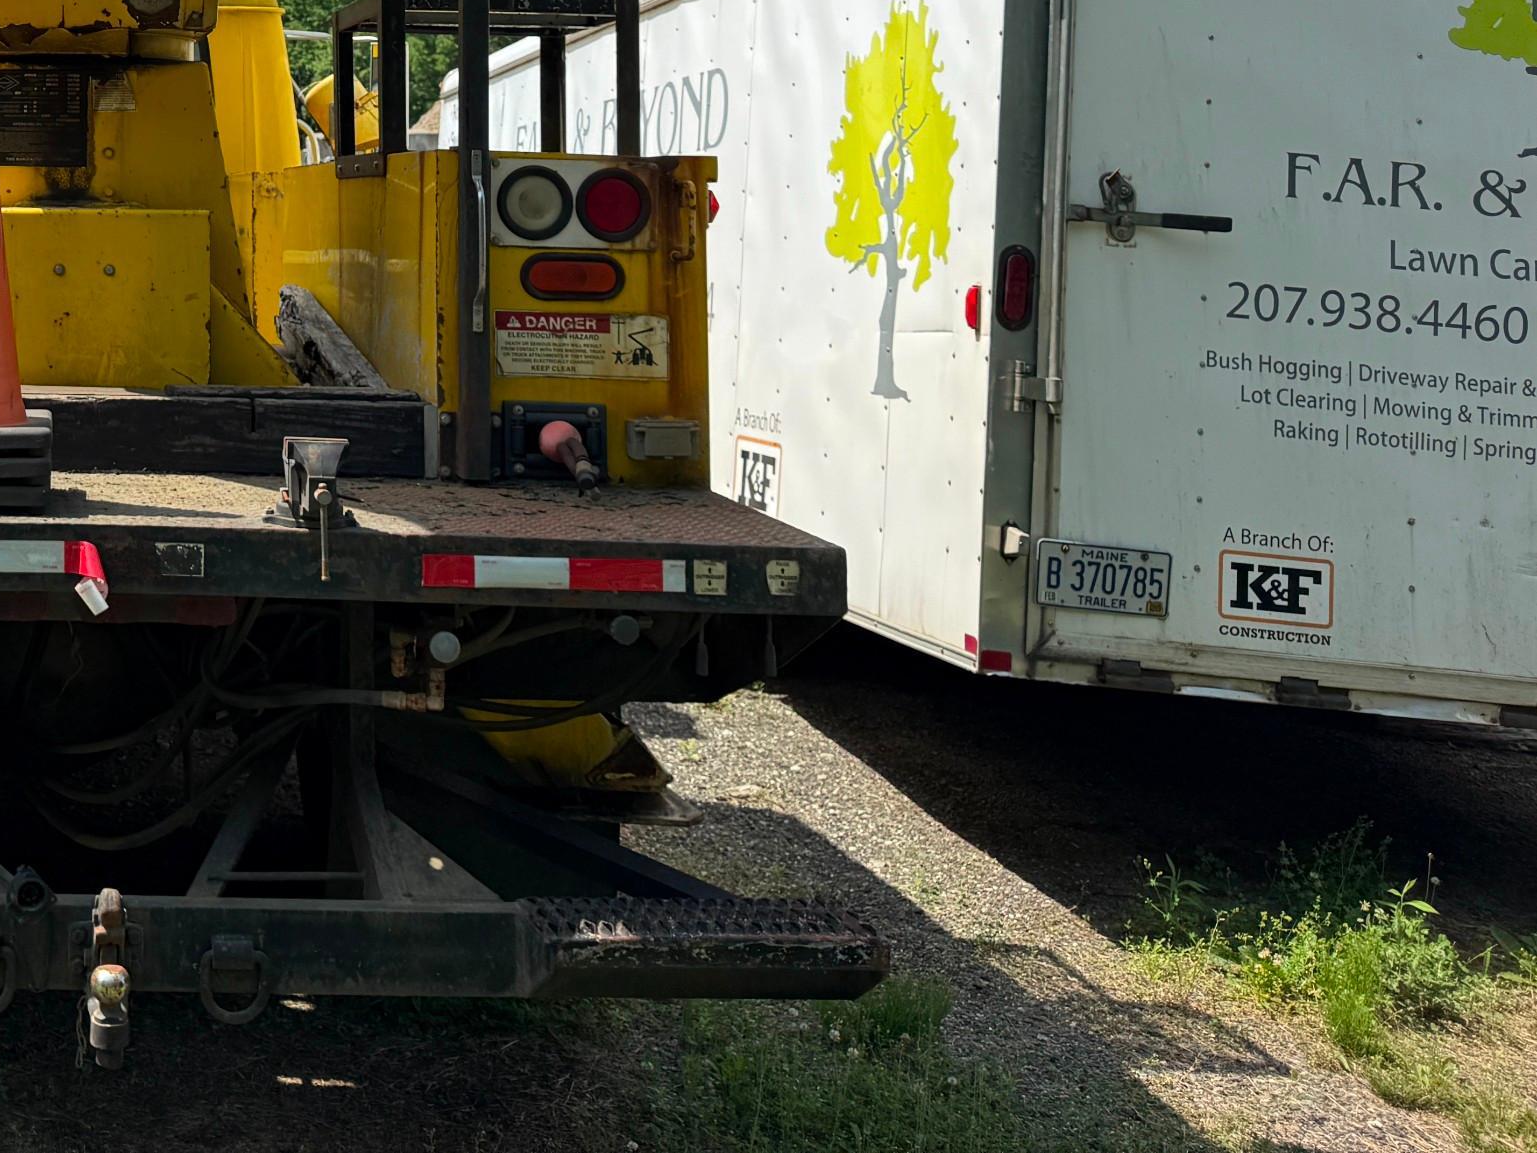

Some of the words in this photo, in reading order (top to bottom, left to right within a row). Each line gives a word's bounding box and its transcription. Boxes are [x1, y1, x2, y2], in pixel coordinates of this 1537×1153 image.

[601, 67, 729, 157] BYOND
[1285, 152, 1443, 211] F.A.R.
[1472, 169, 1527, 218] &
[1390, 239, 1479, 277] Lawn
[525, 316, 597, 330] DANGER
[1226, 281, 1529, 345] 207.938.4460
[1206, 350, 1252, 371] Bush
[1259, 354, 1342, 384] Hogging
[1359, 364, 1449, 393] Driveway
[1455, 372, 1517, 397] Repair
[1522, 379, 1537, 397] &
[744, 408, 768, 432] Branch
[1241, 385, 1271, 405] Lot
[1276, 388, 1356, 417] Clearing
[1373, 397, 1452, 426] Mowing
[1457, 404, 1472, 423] &
[1274, 419, 1339, 447] Raking
[1356, 427, 1457, 458] Rototilling
[1473, 438, 1537, 465] Spring
[1081, 549, 1129, 563] MAINE
[1223, 527, 1235, 544] A
[1241, 528, 1302, 550] Branch
[1308, 535, 1334, 553] Of:
[1046, 556, 1062, 589] B
[1070, 559, 1164, 599] 370785
[1230, 561, 1322, 615] K&F
[1078, 594, 1127, 609] TRAILER
[1219, 625, 1332, 646] CONSTRUCTION
